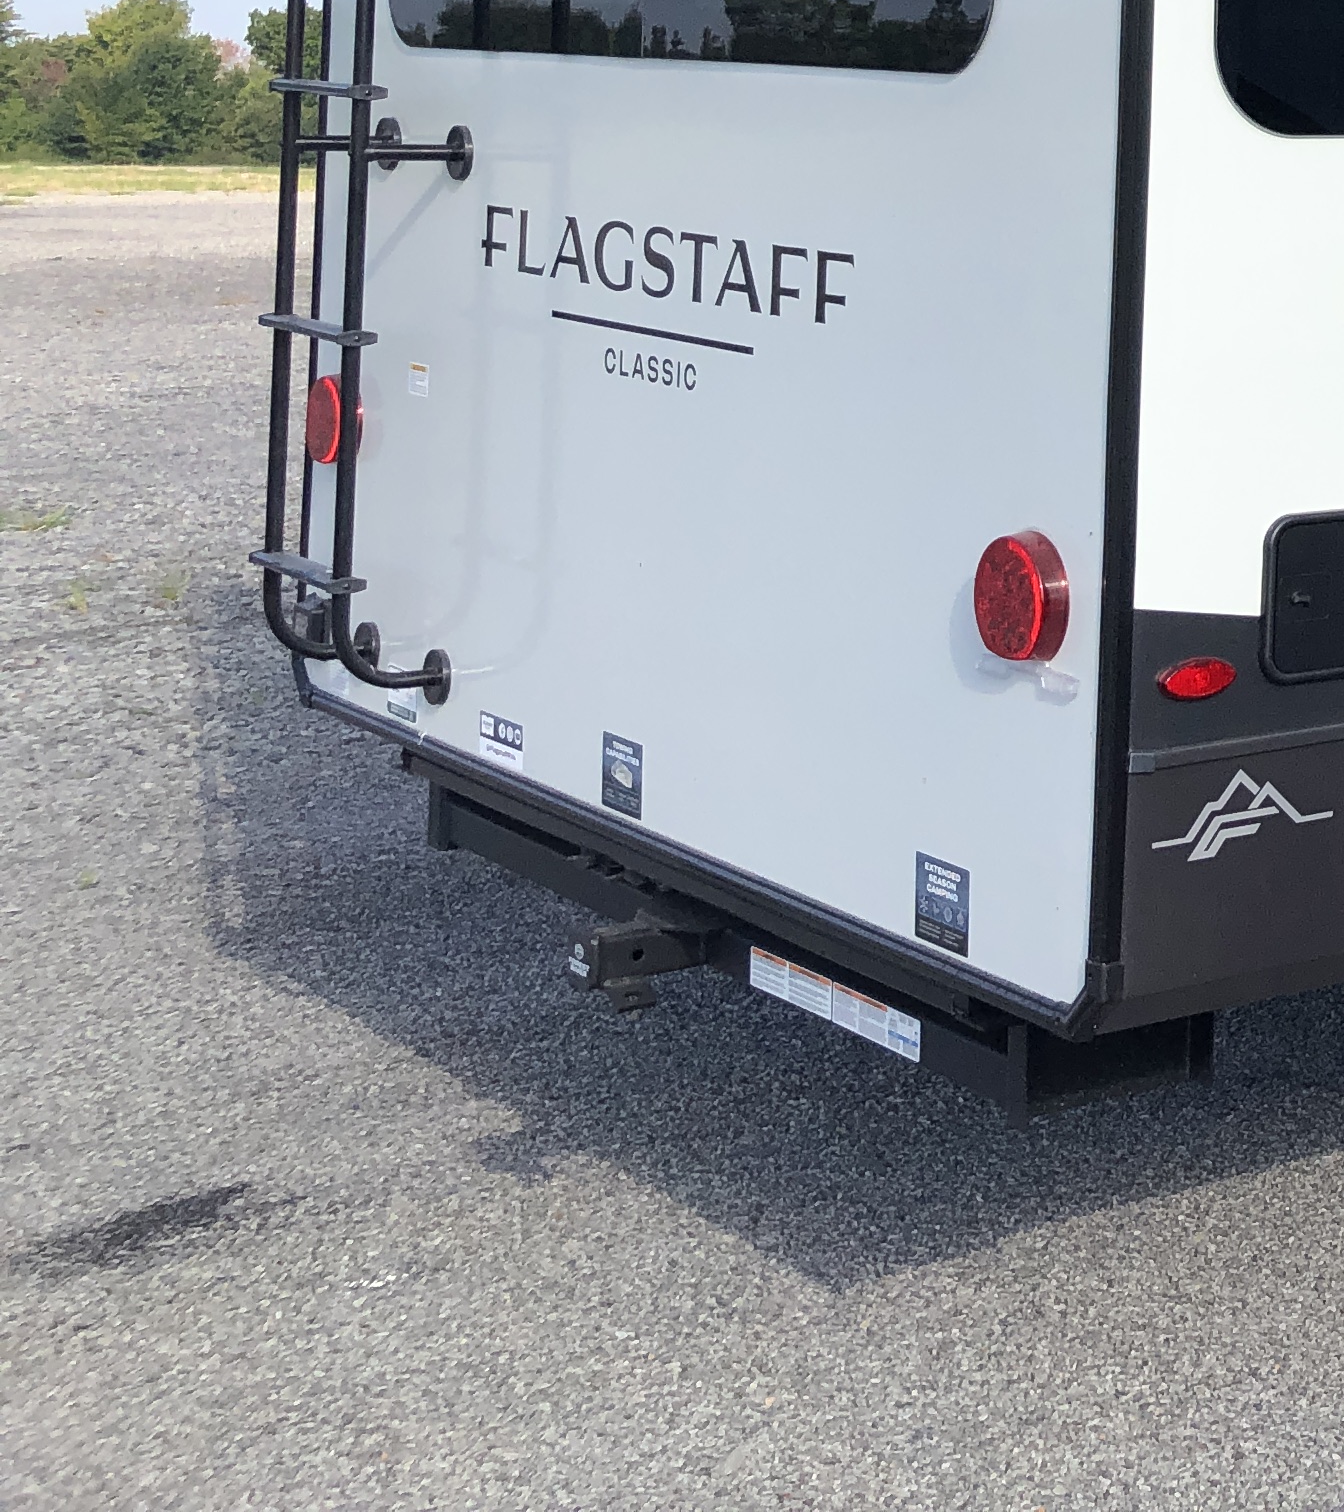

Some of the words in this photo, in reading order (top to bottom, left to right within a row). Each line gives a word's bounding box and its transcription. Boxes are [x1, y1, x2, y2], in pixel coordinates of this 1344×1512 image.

[481, 204, 856, 325] FLAGSTAFF
[604, 347, 698, 391] CLASSIC
[924, 861, 961, 883] EXTENDED
[928, 873, 957, 892] SEASON
[926, 883, 959, 903] CAMPING
